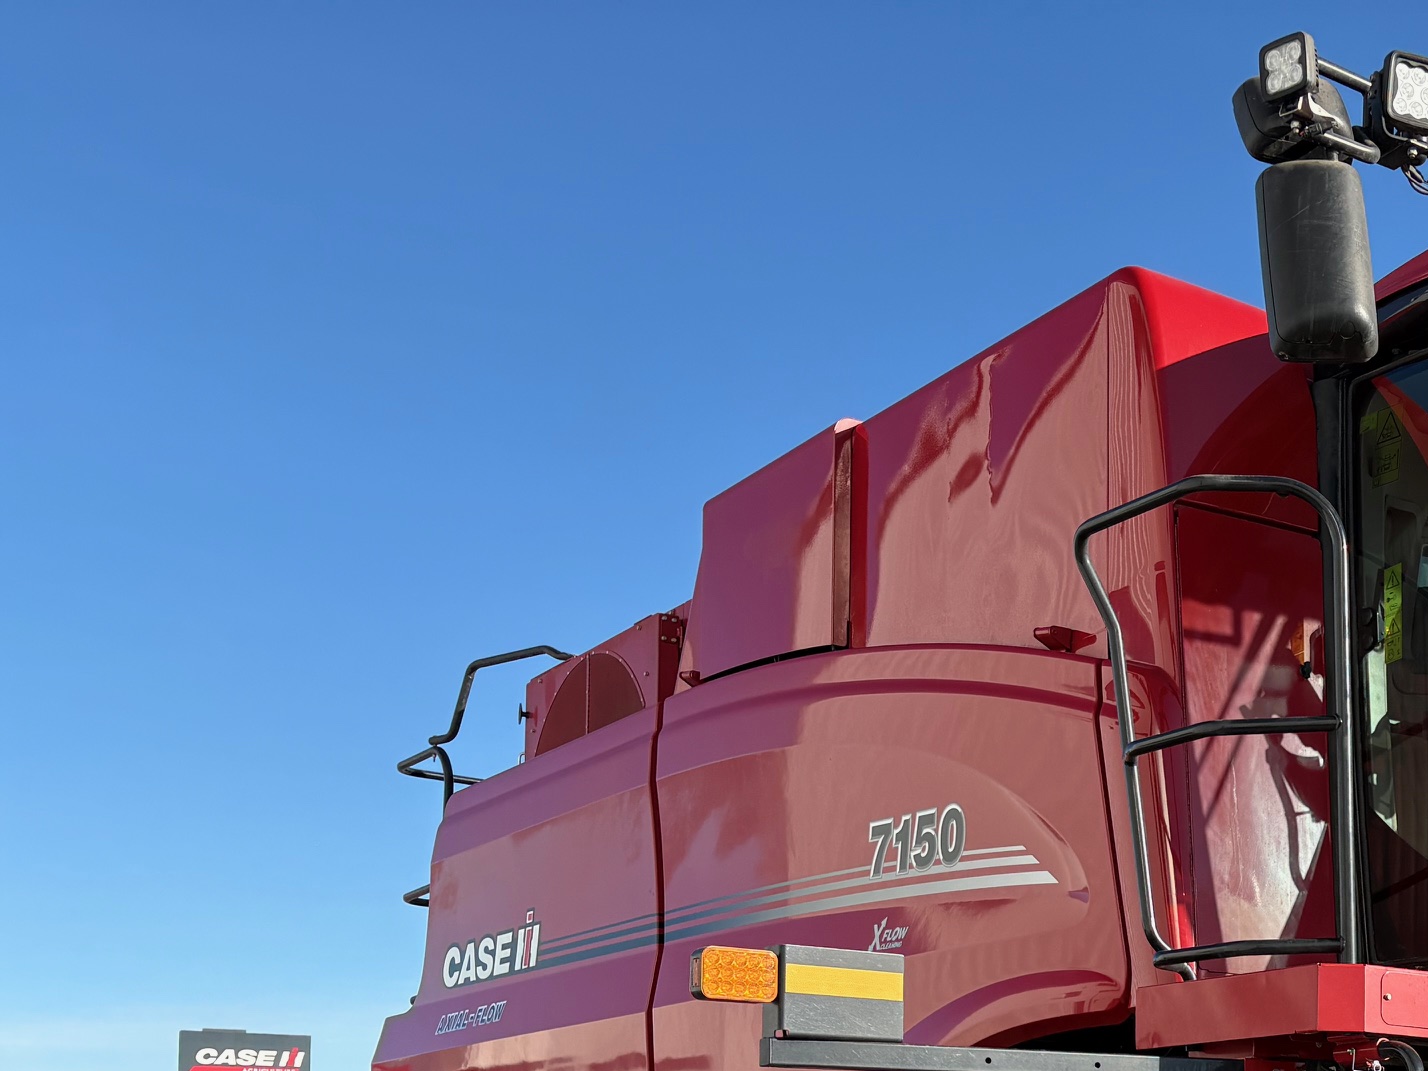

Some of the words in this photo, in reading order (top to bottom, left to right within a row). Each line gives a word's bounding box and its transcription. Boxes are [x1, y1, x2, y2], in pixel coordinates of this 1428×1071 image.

[868, 802, 966, 880] 7150
[442, 931, 514, 988] CASE
[434, 1000, 508, 1036] AXIAL-FLOW
[195, 1047, 278, 1067] CASE
